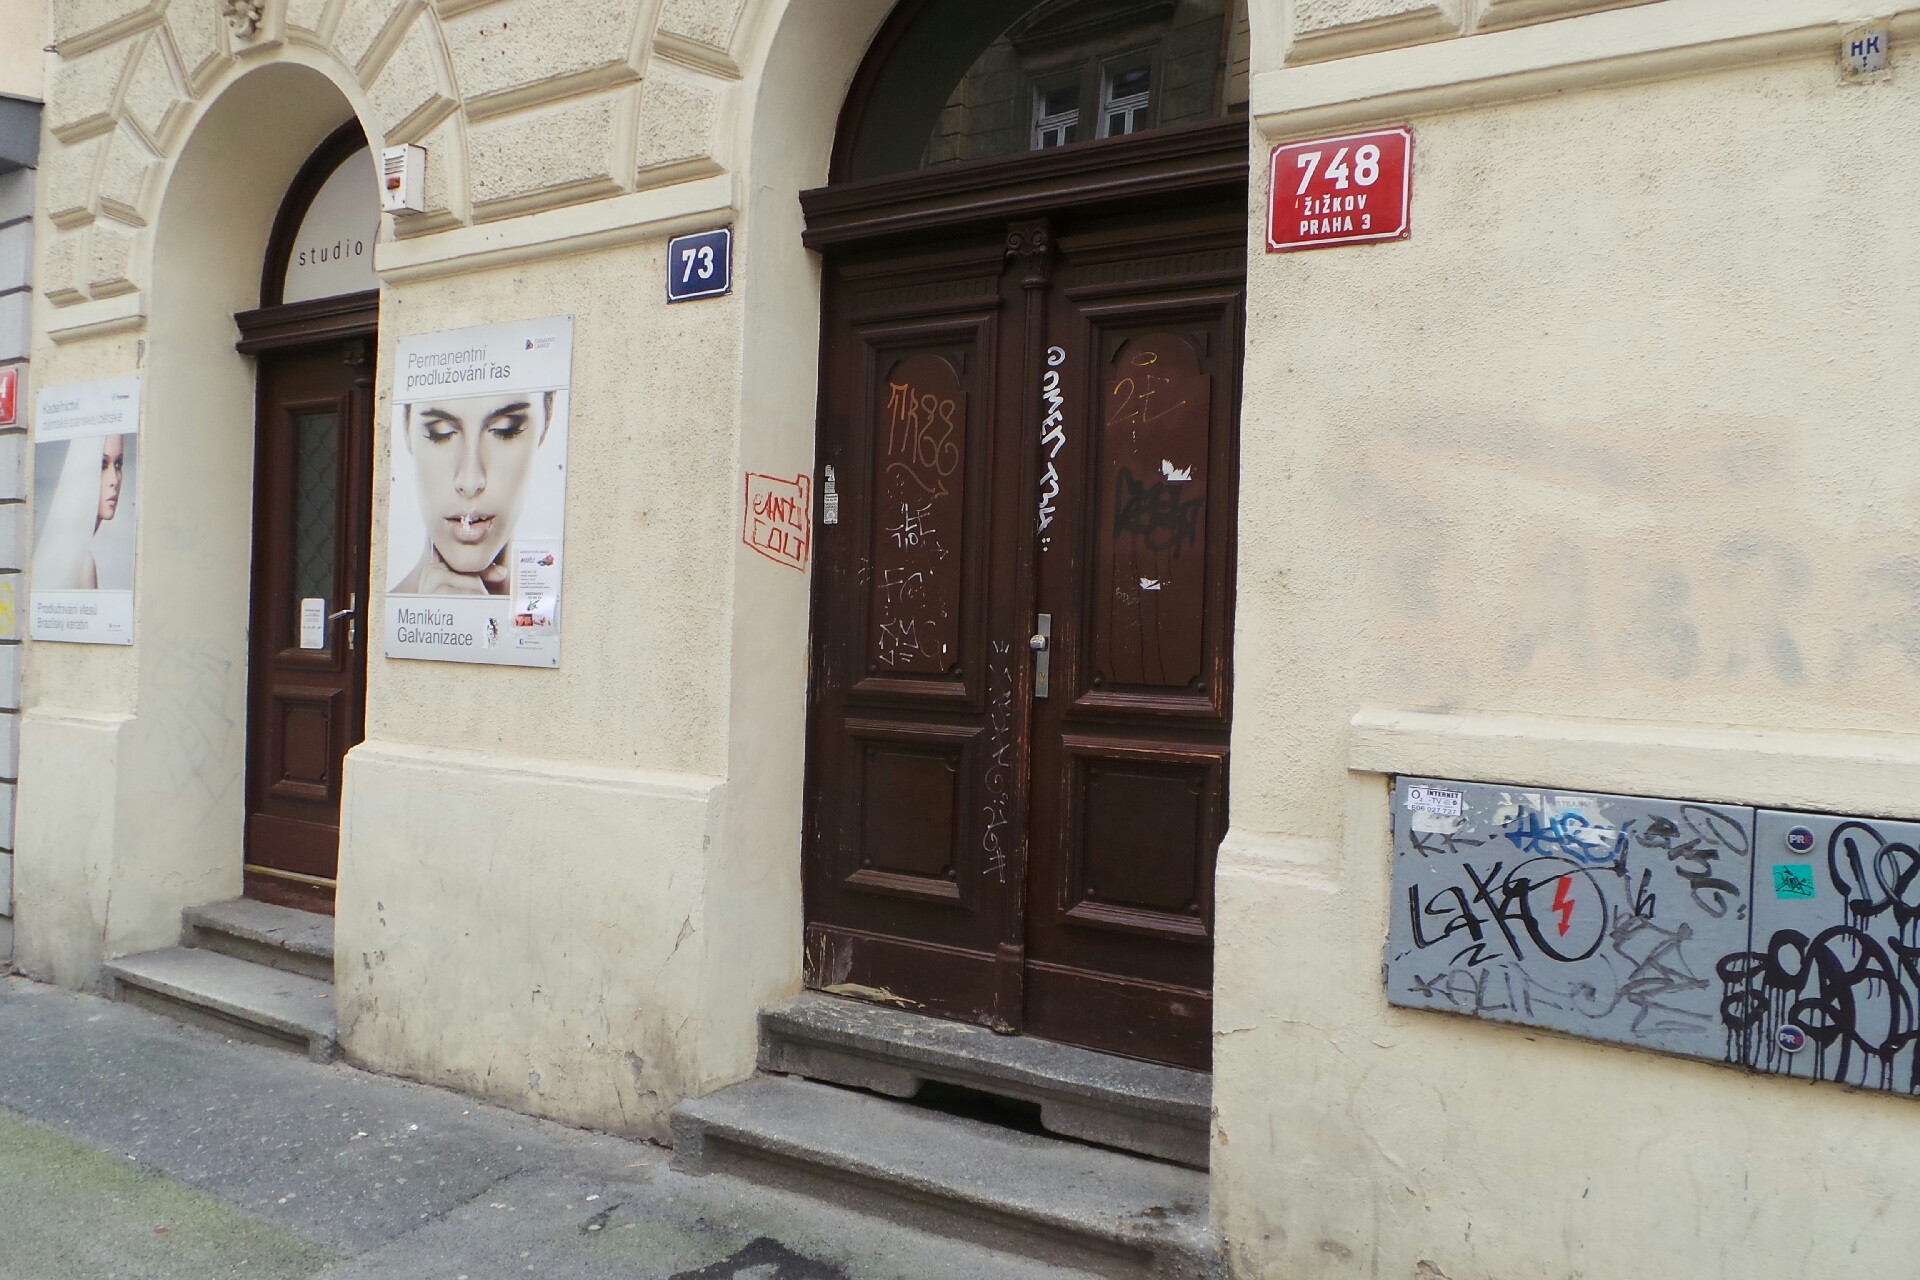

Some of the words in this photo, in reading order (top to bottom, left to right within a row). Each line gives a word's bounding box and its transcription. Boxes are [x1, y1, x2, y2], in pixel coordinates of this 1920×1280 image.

[1851, 36, 1880, 57] HK
[1296, 144, 1380, 196] 748
[1303, 193, 1368, 216] ŽIŽKOV
[1300, 215, 1353, 236] PRAHA
[1361, 213, 1371, 230] 3
[299, 239, 363, 266] studio
[682, 245, 714, 283] 73
[408, 344, 488, 369] Permanentní
[406, 364, 486, 391] prodlužování
[489, 363, 511, 380] řas
[398, 608, 454, 627] Manikúra
[397, 626, 473, 646] Galvanizace
[1427, 790, 1459, 799] INTERNET
